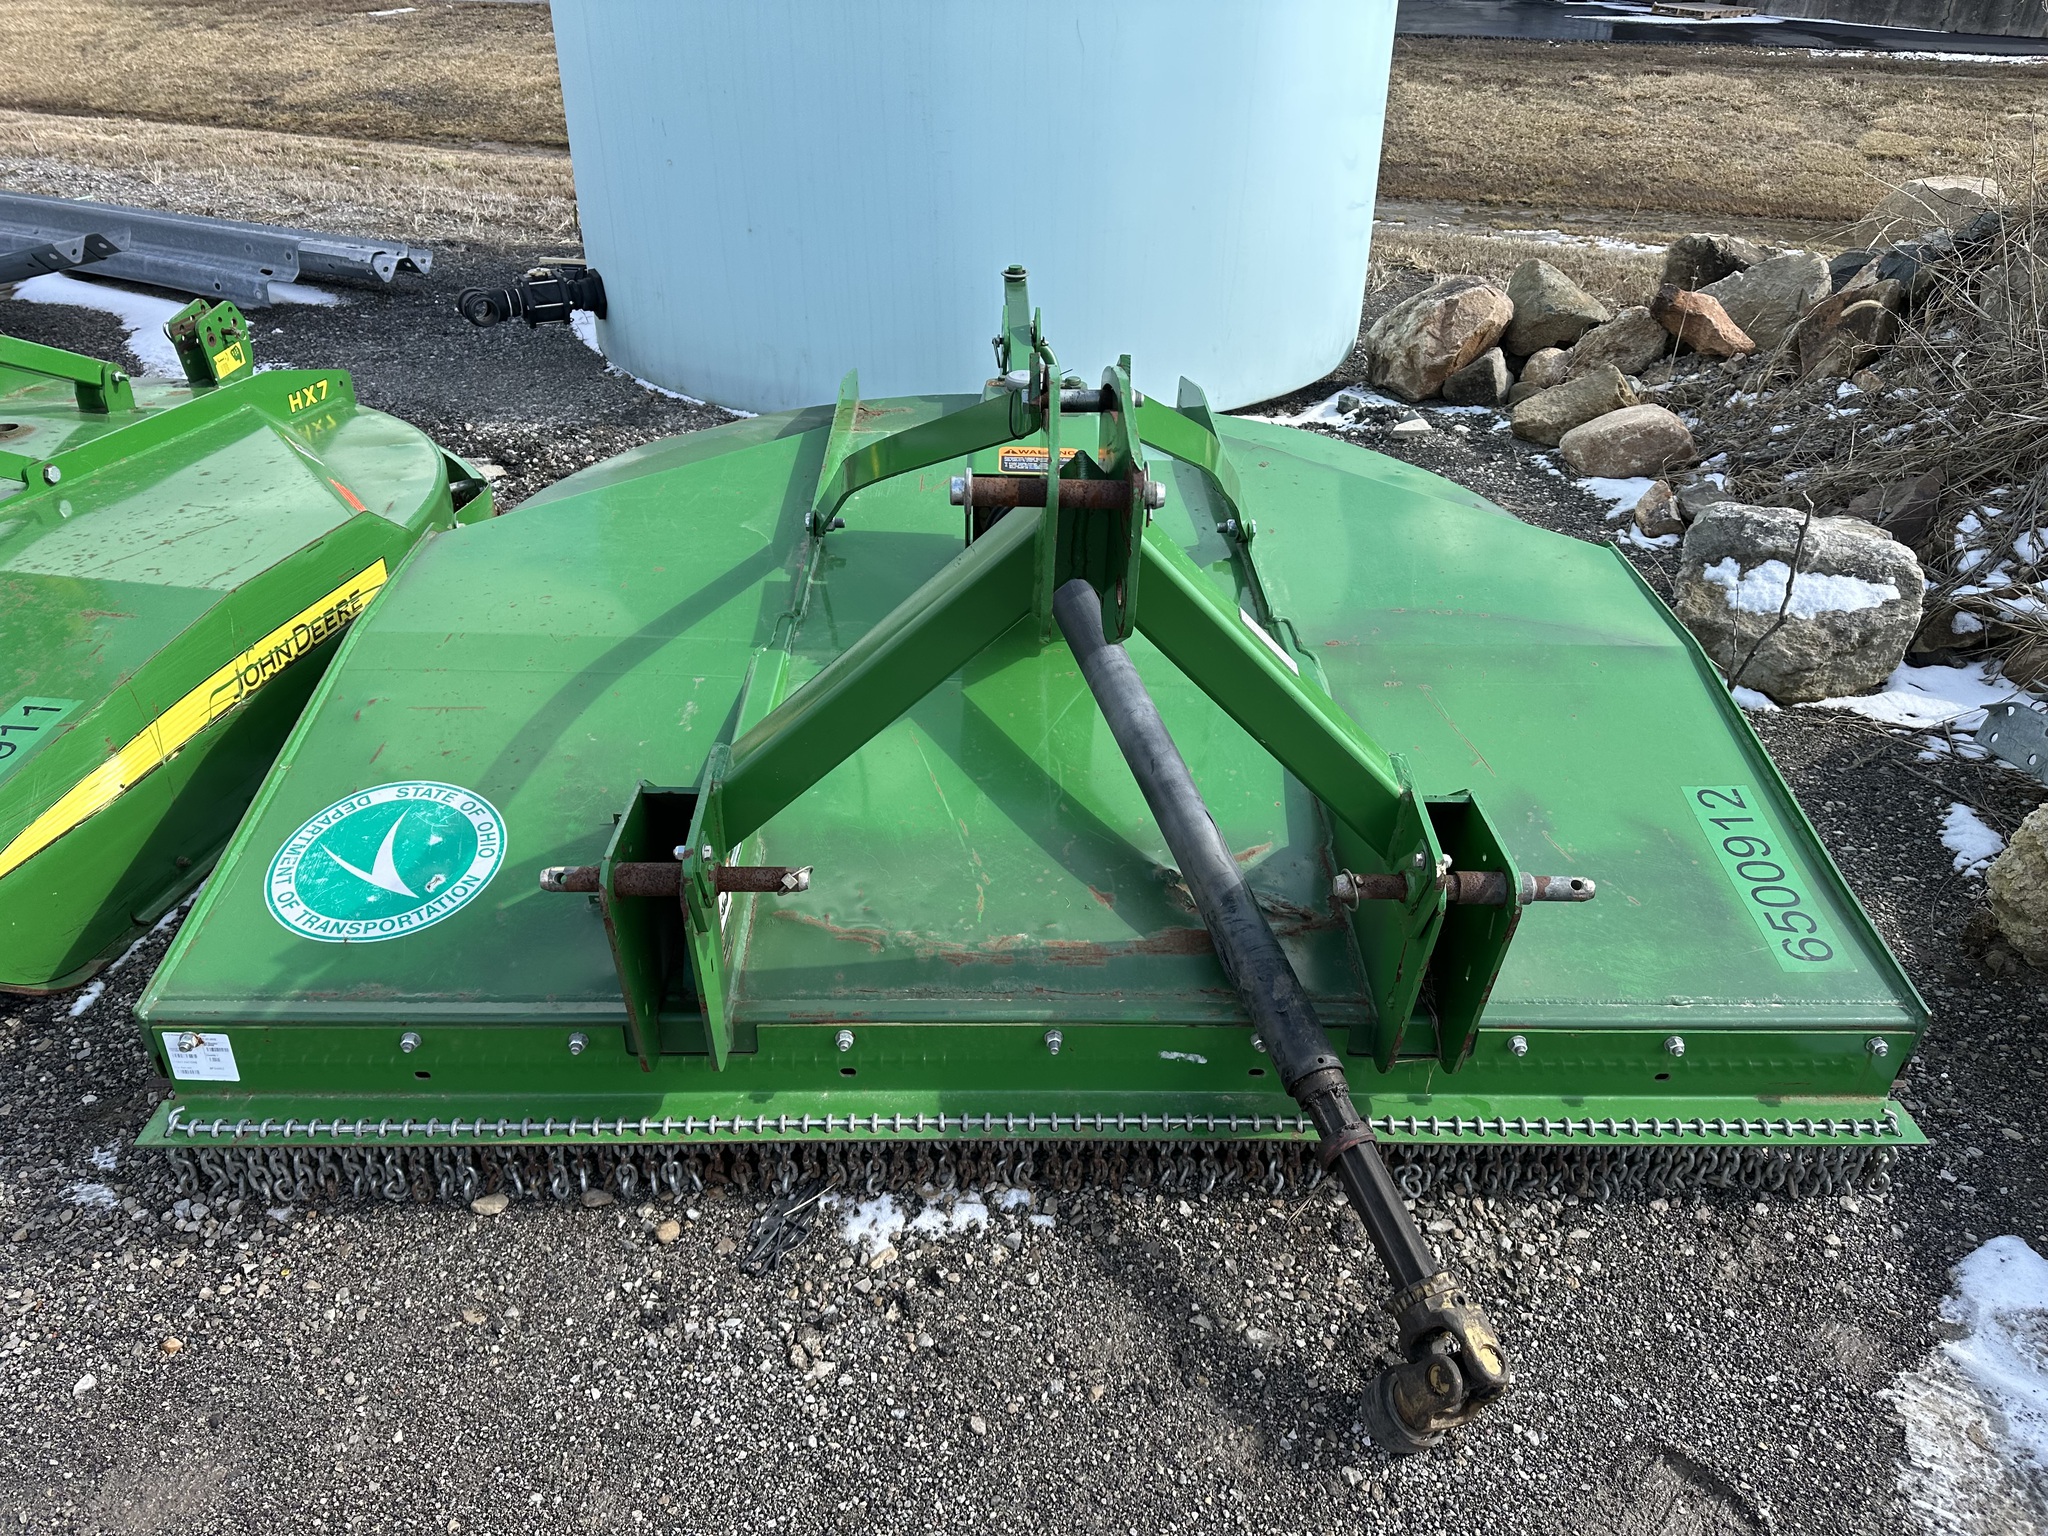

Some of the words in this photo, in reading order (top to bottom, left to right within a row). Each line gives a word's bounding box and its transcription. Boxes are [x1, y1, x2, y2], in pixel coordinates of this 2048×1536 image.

[287, 378, 329, 414] HX7
[233, 638, 292, 700] JOHN
[292, 588, 363, 652] DEERE
[274, 795, 372, 884] DEPARTMENT
[396, 787, 459, 804] STATE
[460, 800, 486, 819] OF
[477, 821, 497, 859] OHIO
[276, 891, 301, 910] OF
[293, 874, 481, 935] TRANSPORTATION
[1696, 788, 1834, 962] 6500912
